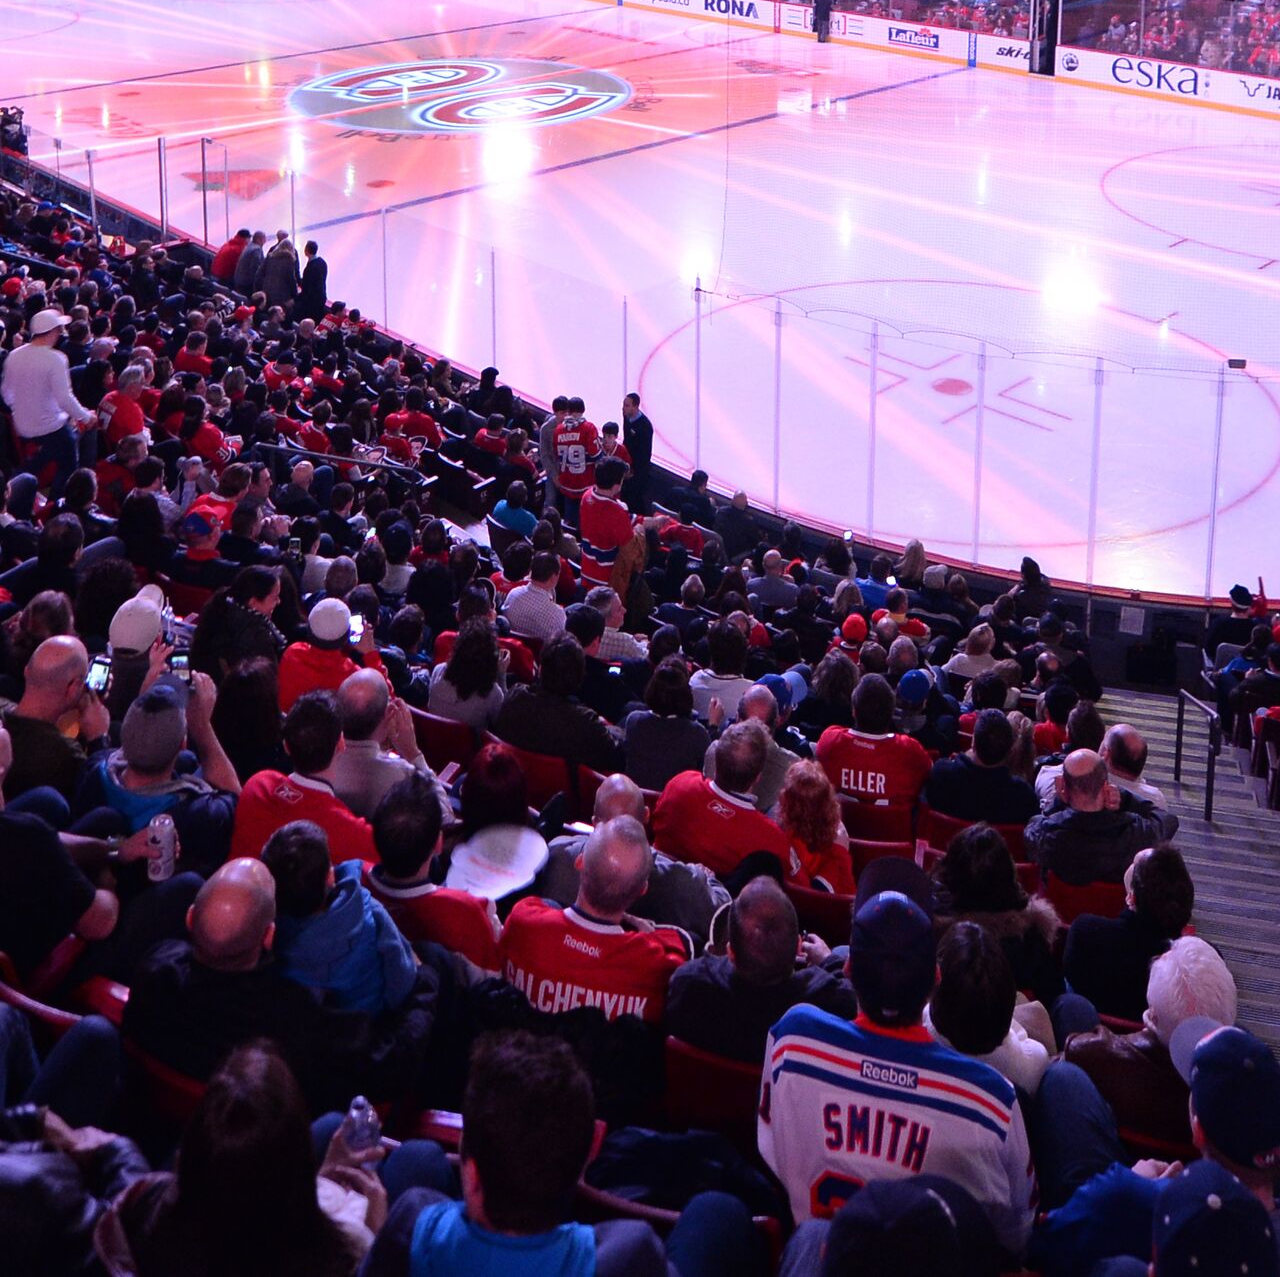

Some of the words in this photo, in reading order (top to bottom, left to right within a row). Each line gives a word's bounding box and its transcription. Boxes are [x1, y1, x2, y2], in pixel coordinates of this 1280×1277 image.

[891, 29, 937, 47] Lafleur
[1111, 56, 1199, 96] eska
[557, 444, 585, 474] 79
[841, 767, 886, 794] ELLER
[563, 933, 602, 958] Reebok
[862, 1060, 916, 1087] Reebok
[824, 1102, 932, 1173] SMITH
